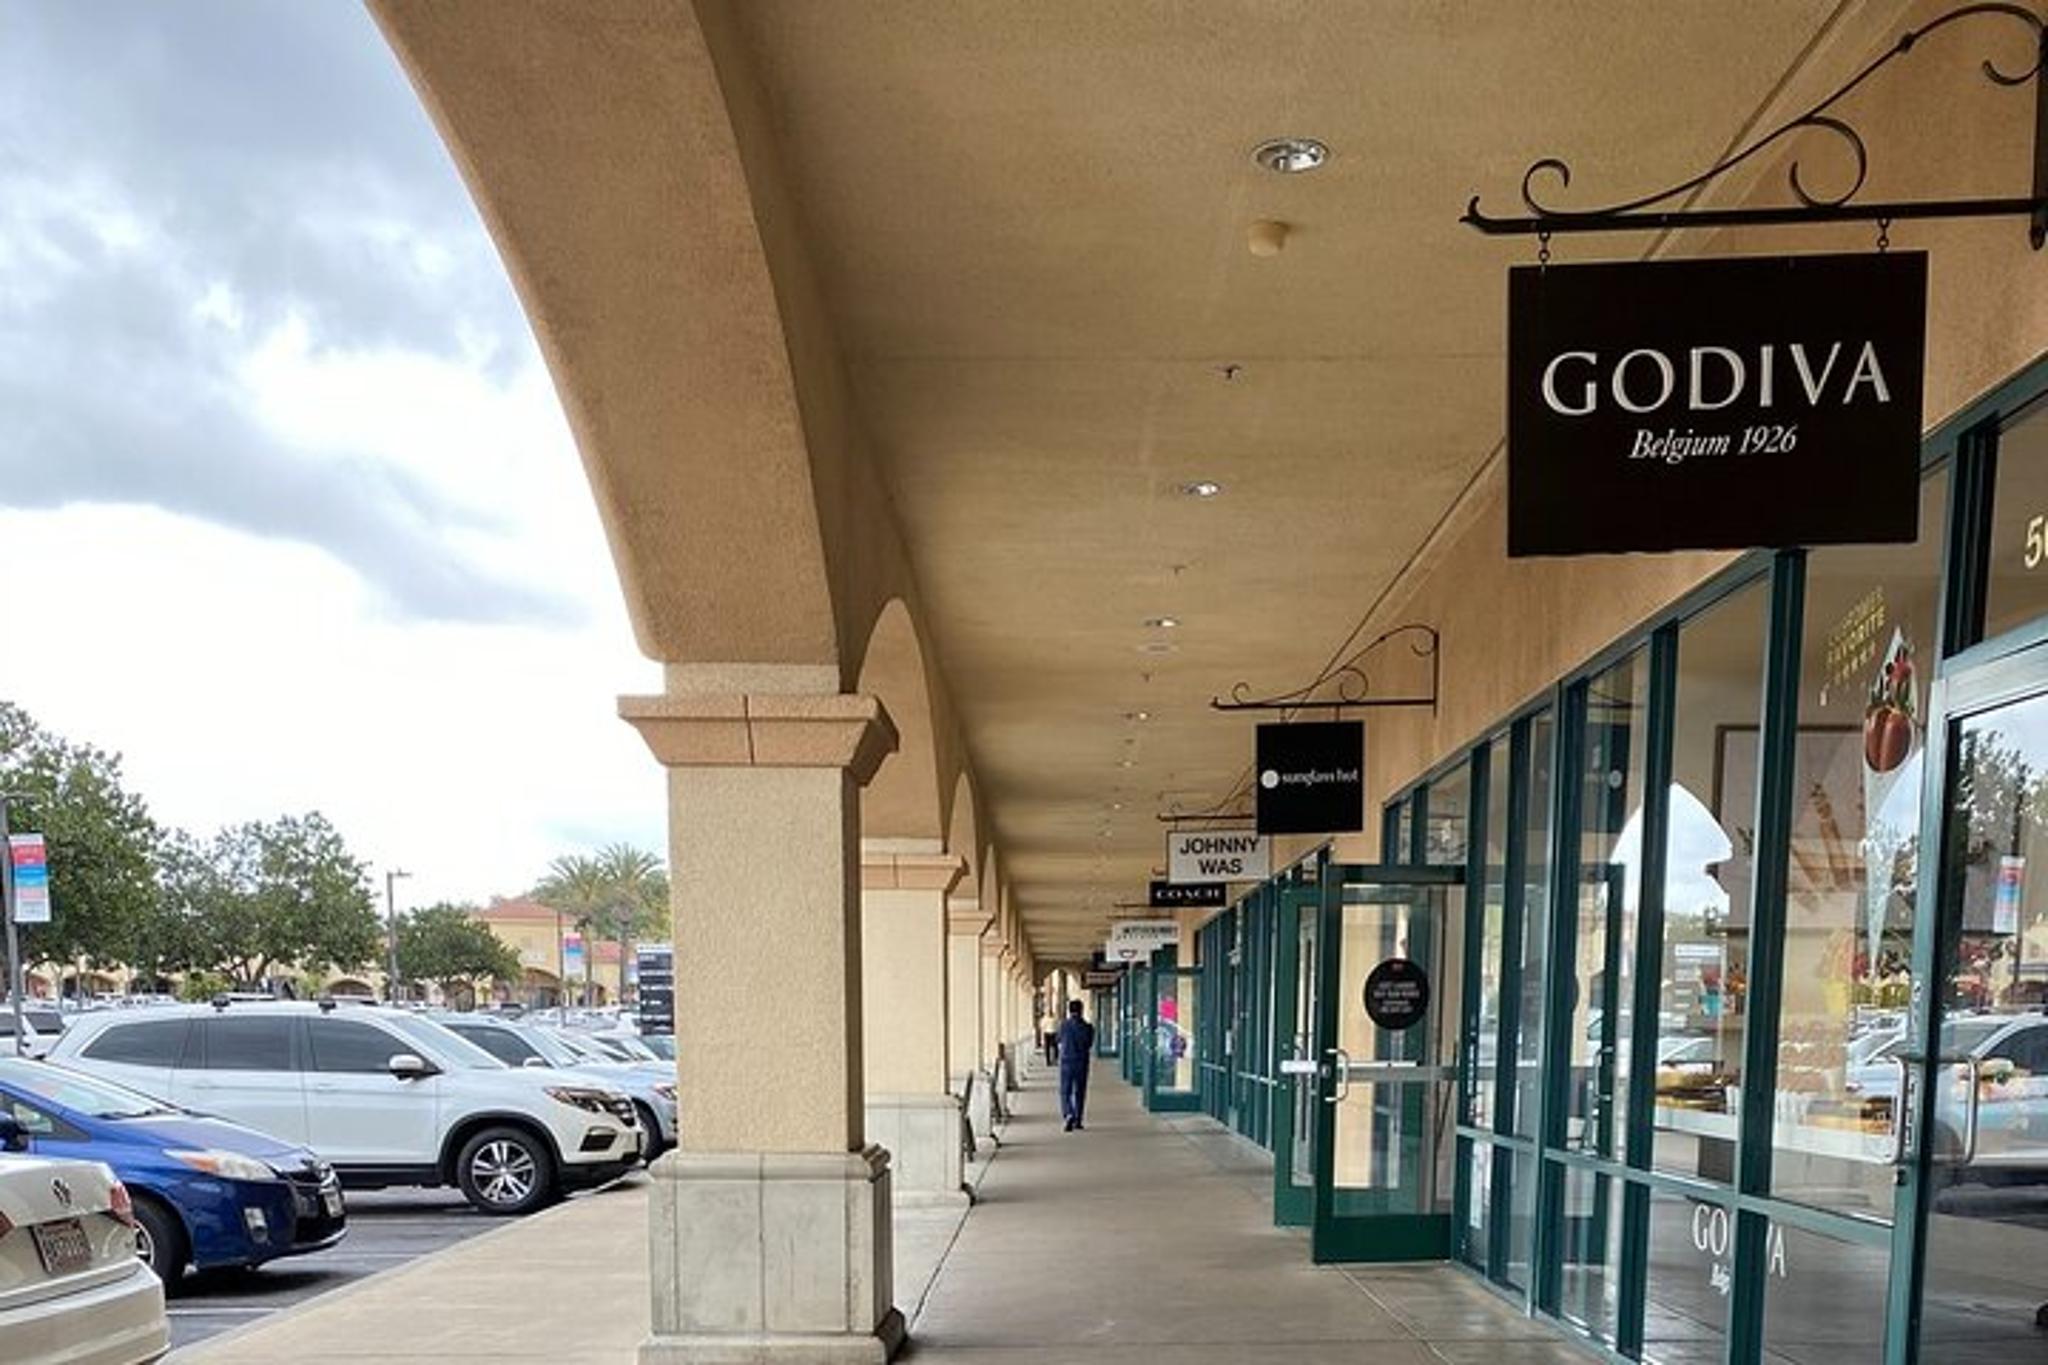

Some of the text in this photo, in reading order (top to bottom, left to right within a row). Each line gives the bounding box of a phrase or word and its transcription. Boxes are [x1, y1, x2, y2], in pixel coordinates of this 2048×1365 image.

[1541, 340, 1890, 416] GODIVA
[1629, 424, 1798, 464] Belgium 1926
[2024, 514, 2048, 569] 5
[1180, 838, 1259, 854] JOHNNY
[1198, 858, 1243, 874] WAS
[1693, 1204, 1786, 1278] GOA
